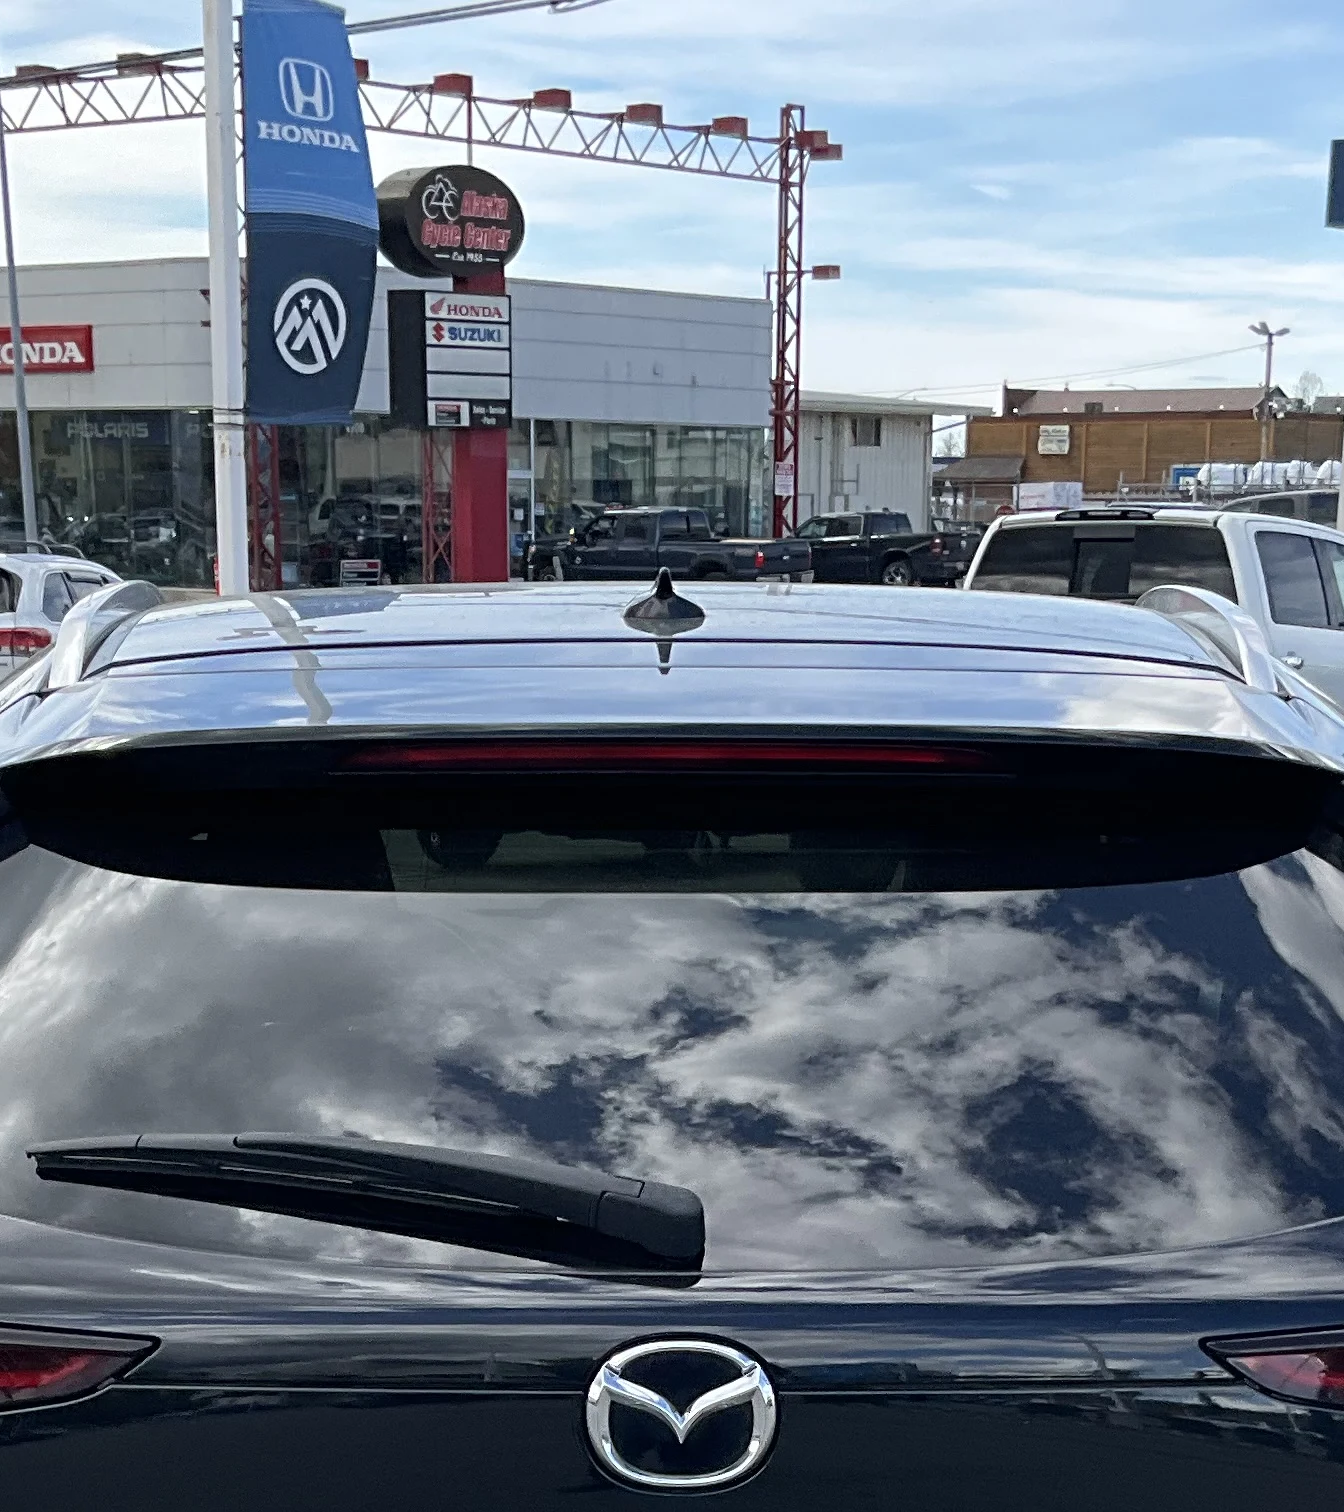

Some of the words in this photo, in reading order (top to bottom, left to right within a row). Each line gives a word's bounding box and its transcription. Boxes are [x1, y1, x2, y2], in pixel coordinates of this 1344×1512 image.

[257, 119, 360, 154] HONDA
[447, 304, 503, 319] HONDA
[447, 325, 501, 343] SUZUKI
[67, 422, 149, 439] POLARIS
